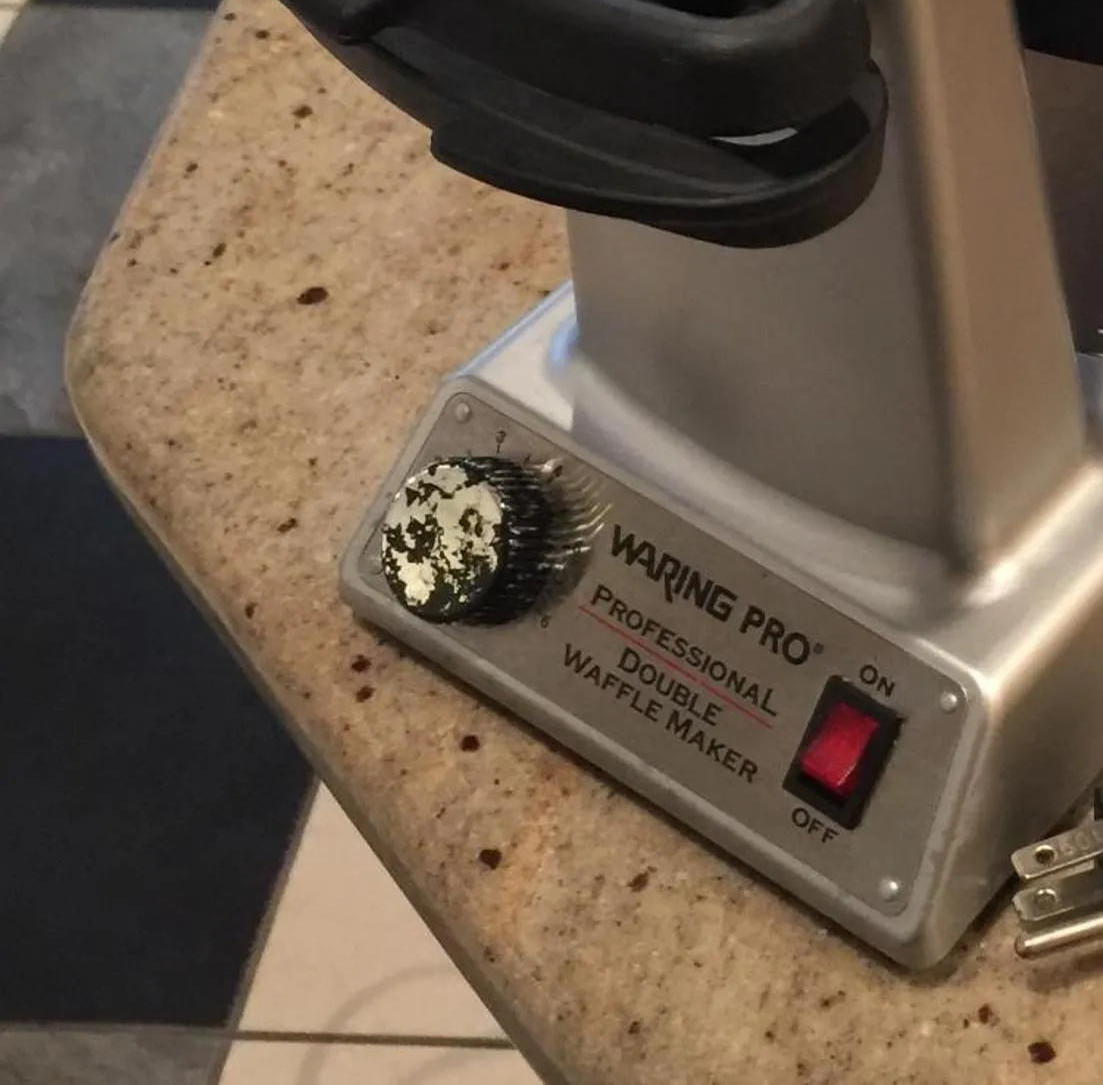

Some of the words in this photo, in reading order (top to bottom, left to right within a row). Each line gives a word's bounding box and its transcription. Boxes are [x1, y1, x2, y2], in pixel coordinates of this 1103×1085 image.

[613, 524, 738, 623] WARING
[591, 583, 778, 717] PROFESSIONAL
[617, 647, 724, 726] DOUBLE
[859, 664, 895, 697] ON
[564, 643, 664, 722] WAFFLE
[664, 711, 758, 784] MAKER
[791, 807, 838, 843] OFF
